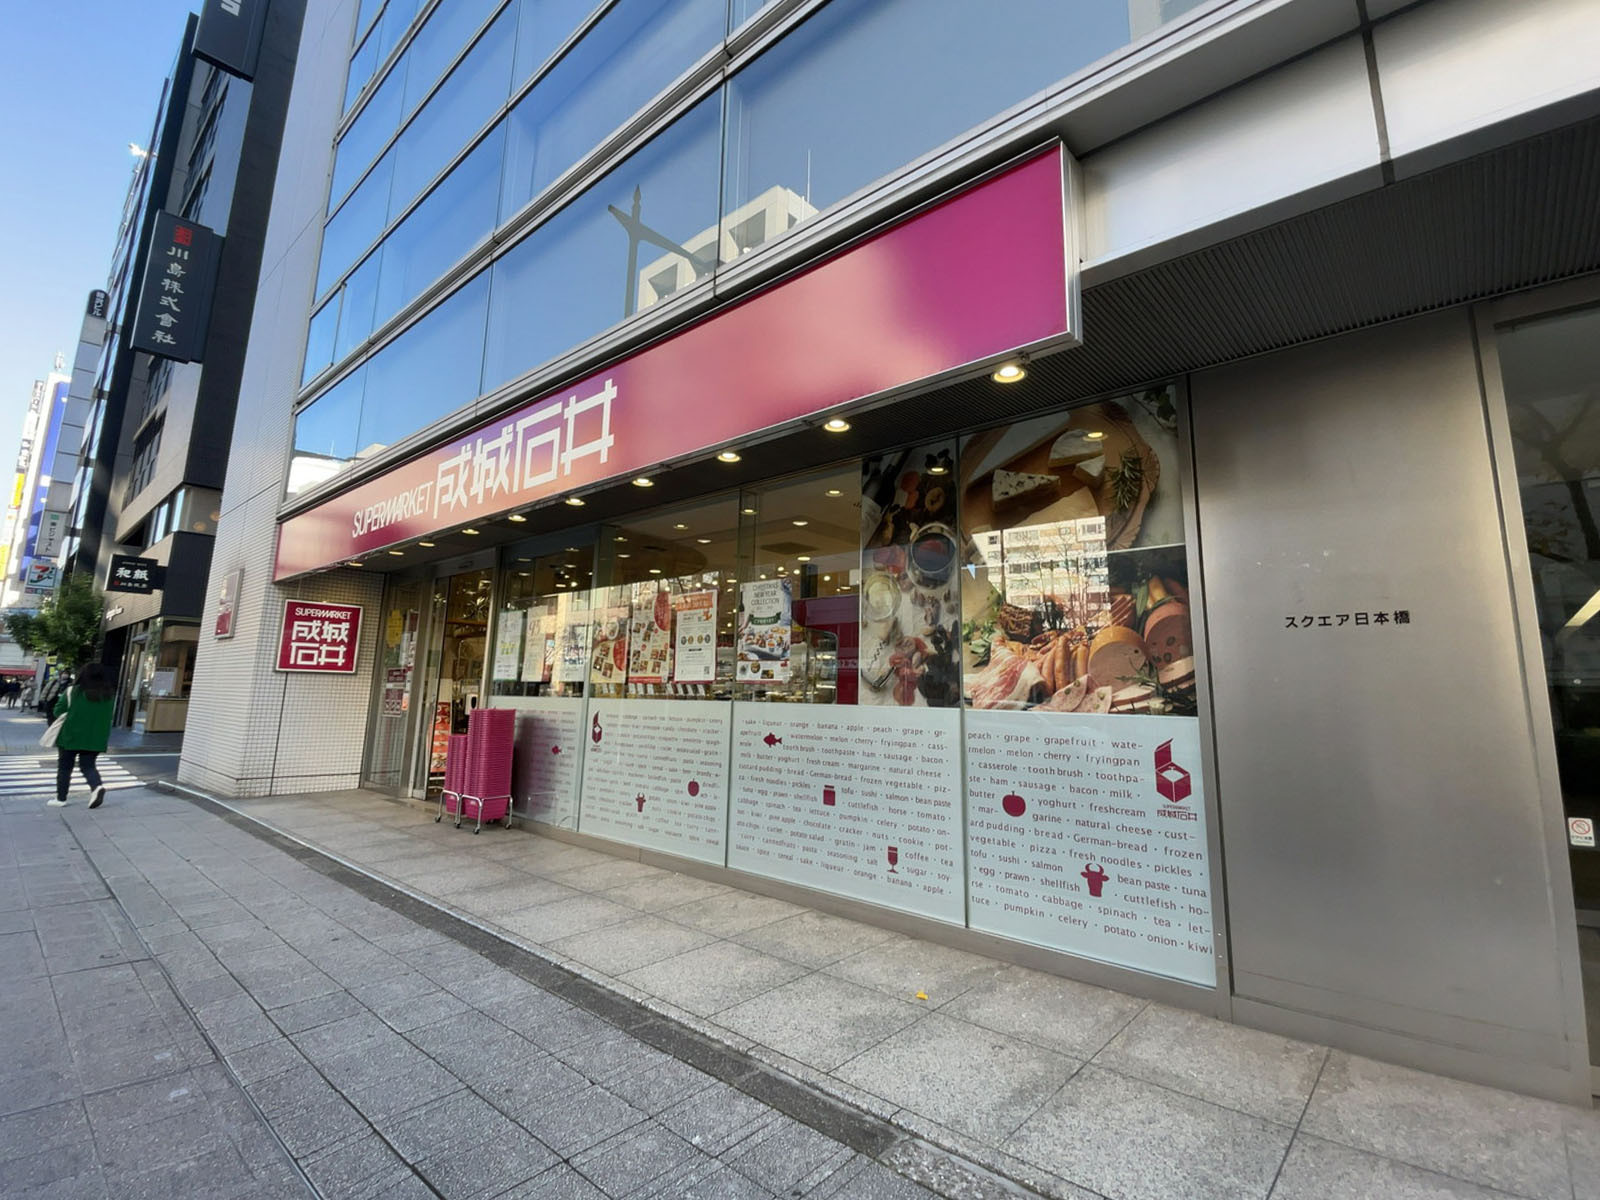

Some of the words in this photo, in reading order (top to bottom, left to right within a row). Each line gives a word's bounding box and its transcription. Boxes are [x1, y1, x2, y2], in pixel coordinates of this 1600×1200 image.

[352, 481, 434, 538] SUPERMARKET
[434, 378, 617, 519] 成城石井
[116, 568, 149, 581] 和紙
[295, 606, 353, 621] SUPERMARKET
[1285, 610, 1410, 628] スクエア日本橋
[292, 620, 350, 643] 成城
[289, 643, 346, 667] 石井
[902, 728, 923, 736] grape
[968, 731, 992, 741] peach
[1004, 733, 1030, 744] grape
[1044, 735, 1096, 747] grapefruit
[1111, 740, 1143, 750] wate-
[884, 753, 912, 762] sausage
[922, 756, 943, 764] bacon
[968, 746, 995, 756] rmelon
[1006, 748, 1033, 758] melon
[1043, 751, 1071, 762] cherry
[1086, 753, 1140, 768] fryingpan
[978, 761, 1017, 772] casserole
[861, 775, 882, 785] frozen
[885, 779, 923, 789] vegetable
[917, 769, 941, 778] cheese
[969, 775, 981, 784] ste
[990, 776, 1008, 786] ham
[1018, 780, 1056, 792] sausage
[1069, 784, 1098, 796] bacon
[1110, 788, 1133, 799] milk
[970, 789, 995, 799] butter
[1037, 797, 1077, 810] yoghurt
[1089, 803, 1146, 818] freshcream
[877, 819, 897, 828] celery
[889, 807, 907, 815] horse
[917, 811, 945, 821] tomato
[1032, 813, 1062, 824] garine
[1075, 818, 1110, 830] natural
[1116, 822, 1152, 836] cheese
[872, 832, 889, 840] nuts
[899, 836, 924, 847] cookie
[987, 821, 1024, 835] pudding
[1034, 828, 1063, 840] bread
[1073, 833, 1147, 853] German-bread
[1164, 846, 1203, 861] frozen
[905, 851, 929, 861] coffee
[941, 859, 953, 867] tea
[970, 834, 1016, 849] vegetable
[1030, 844, 1056, 856] pizza
[1069, 848, 1096, 861] fresh
[1101, 854, 1142, 870] noodles
[1154, 863, 1192, 878] pickles
[970, 850, 987, 860] tofu
[998, 854, 1020, 864] sushi
[1031, 859, 1063, 873] salmon
[1117, 873, 1142, 886] bean
[1145, 879, 1170, 892] paste
[1182, 885, 1207, 898] tuna
[923, 884, 944, 894] apple
[979, 868, 995, 878] egg
[1004, 870, 1030, 883] prawn
[1040, 876, 1080, 892] shellfish
[1124, 893, 1177, 911] cuttlefish
[996, 885, 1029, 899] tomato
[1042, 894, 1083, 911] cabbage
[1098, 905, 1138, 922] spinach
[1154, 916, 1171, 929] tea
[972, 895, 991, 906] tuce
[1004, 902, 1045, 918] pumpkin
[1058, 914, 1088, 929] celery
[1104, 924, 1136, 939] potato
[1147, 933, 1177, 948] onion
[1187, 941, 1213, 955] kiwi
